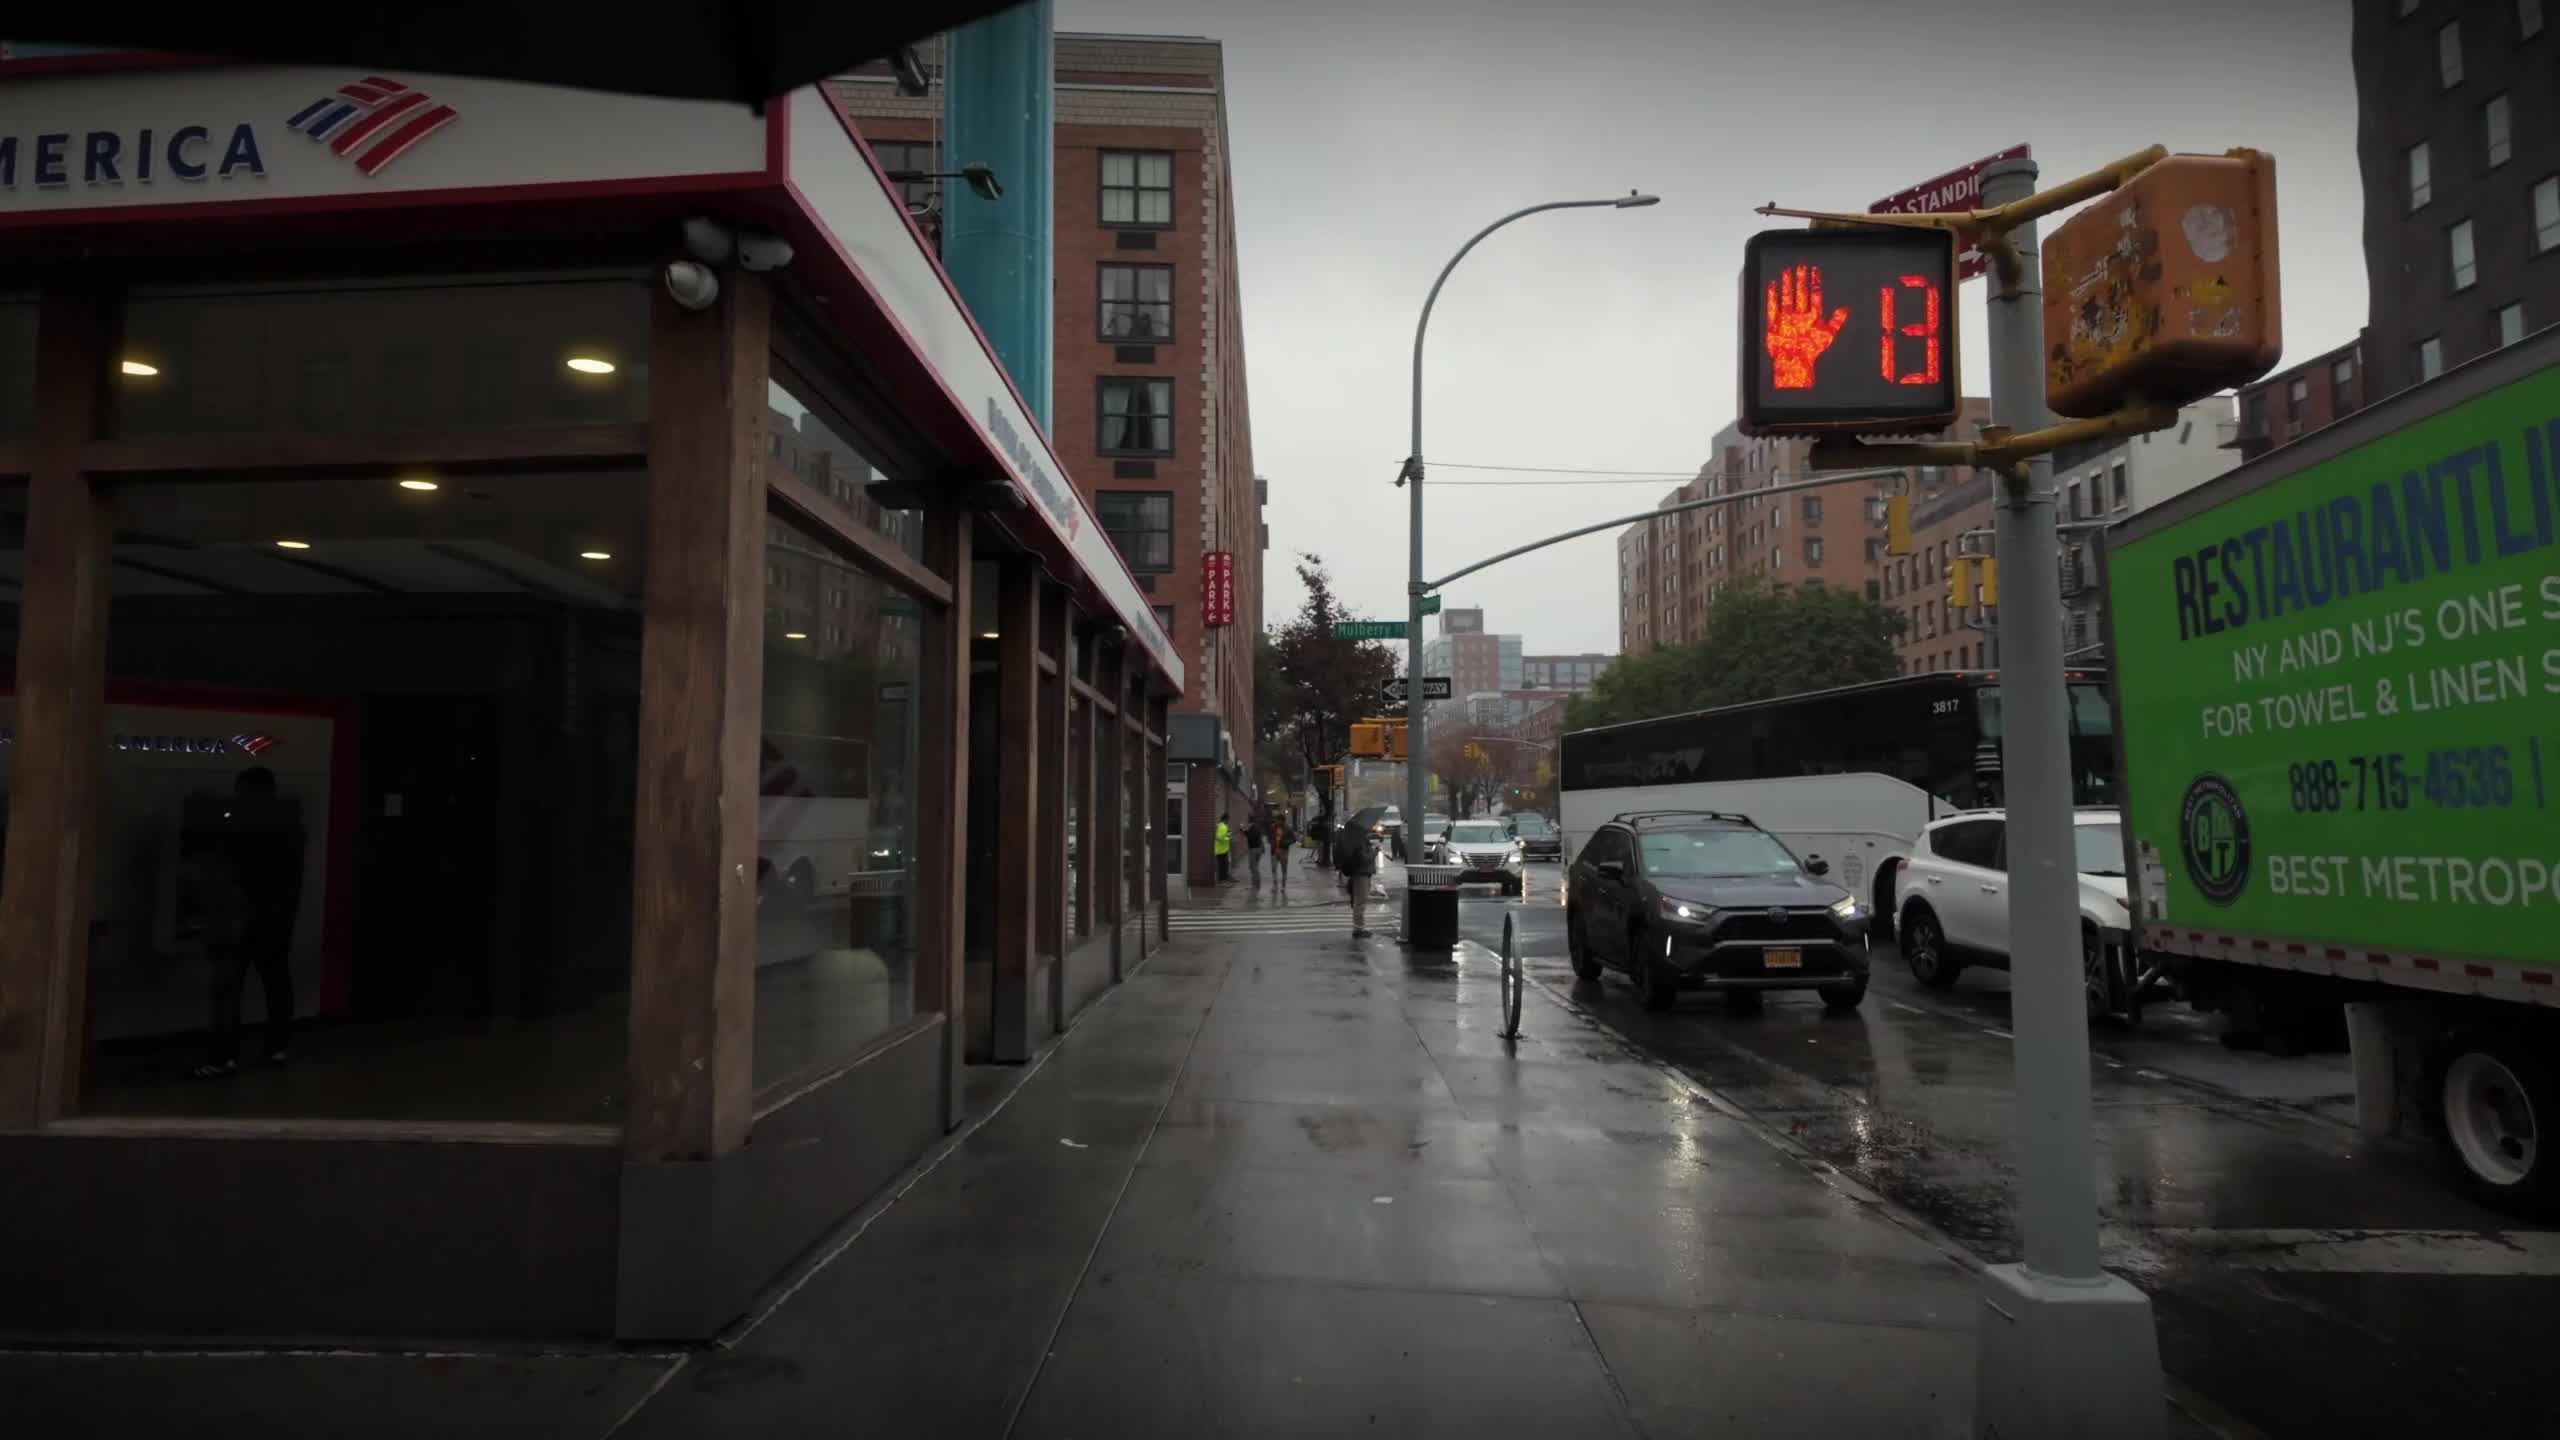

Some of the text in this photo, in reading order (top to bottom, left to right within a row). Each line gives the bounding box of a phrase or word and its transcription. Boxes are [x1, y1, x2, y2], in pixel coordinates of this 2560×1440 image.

[1880, 274, 1939, 384] 13
[1208, 569, 1217, 611] PARK
[1223, 569, 1231, 611] PARK
[1338, 623, 1391, 638] Mulberry
[2233, 643, 2269, 683] NY
[2279, 628, 2342, 673] AND
[2352, 608, 2425, 658] NJ'S
[2437, 583, 2527, 641] ONE
[1932, 698, 1960, 714] 3817
[2202, 702, 2252, 739] FOR
[2259, 684, 2367, 731] TOWEL
[2375, 677, 2399, 717] &
[2407, 655, 2528, 711] LINEN
[2269, 856, 2349, 897] BEST
[2361, 856, 2560, 908] METROP
